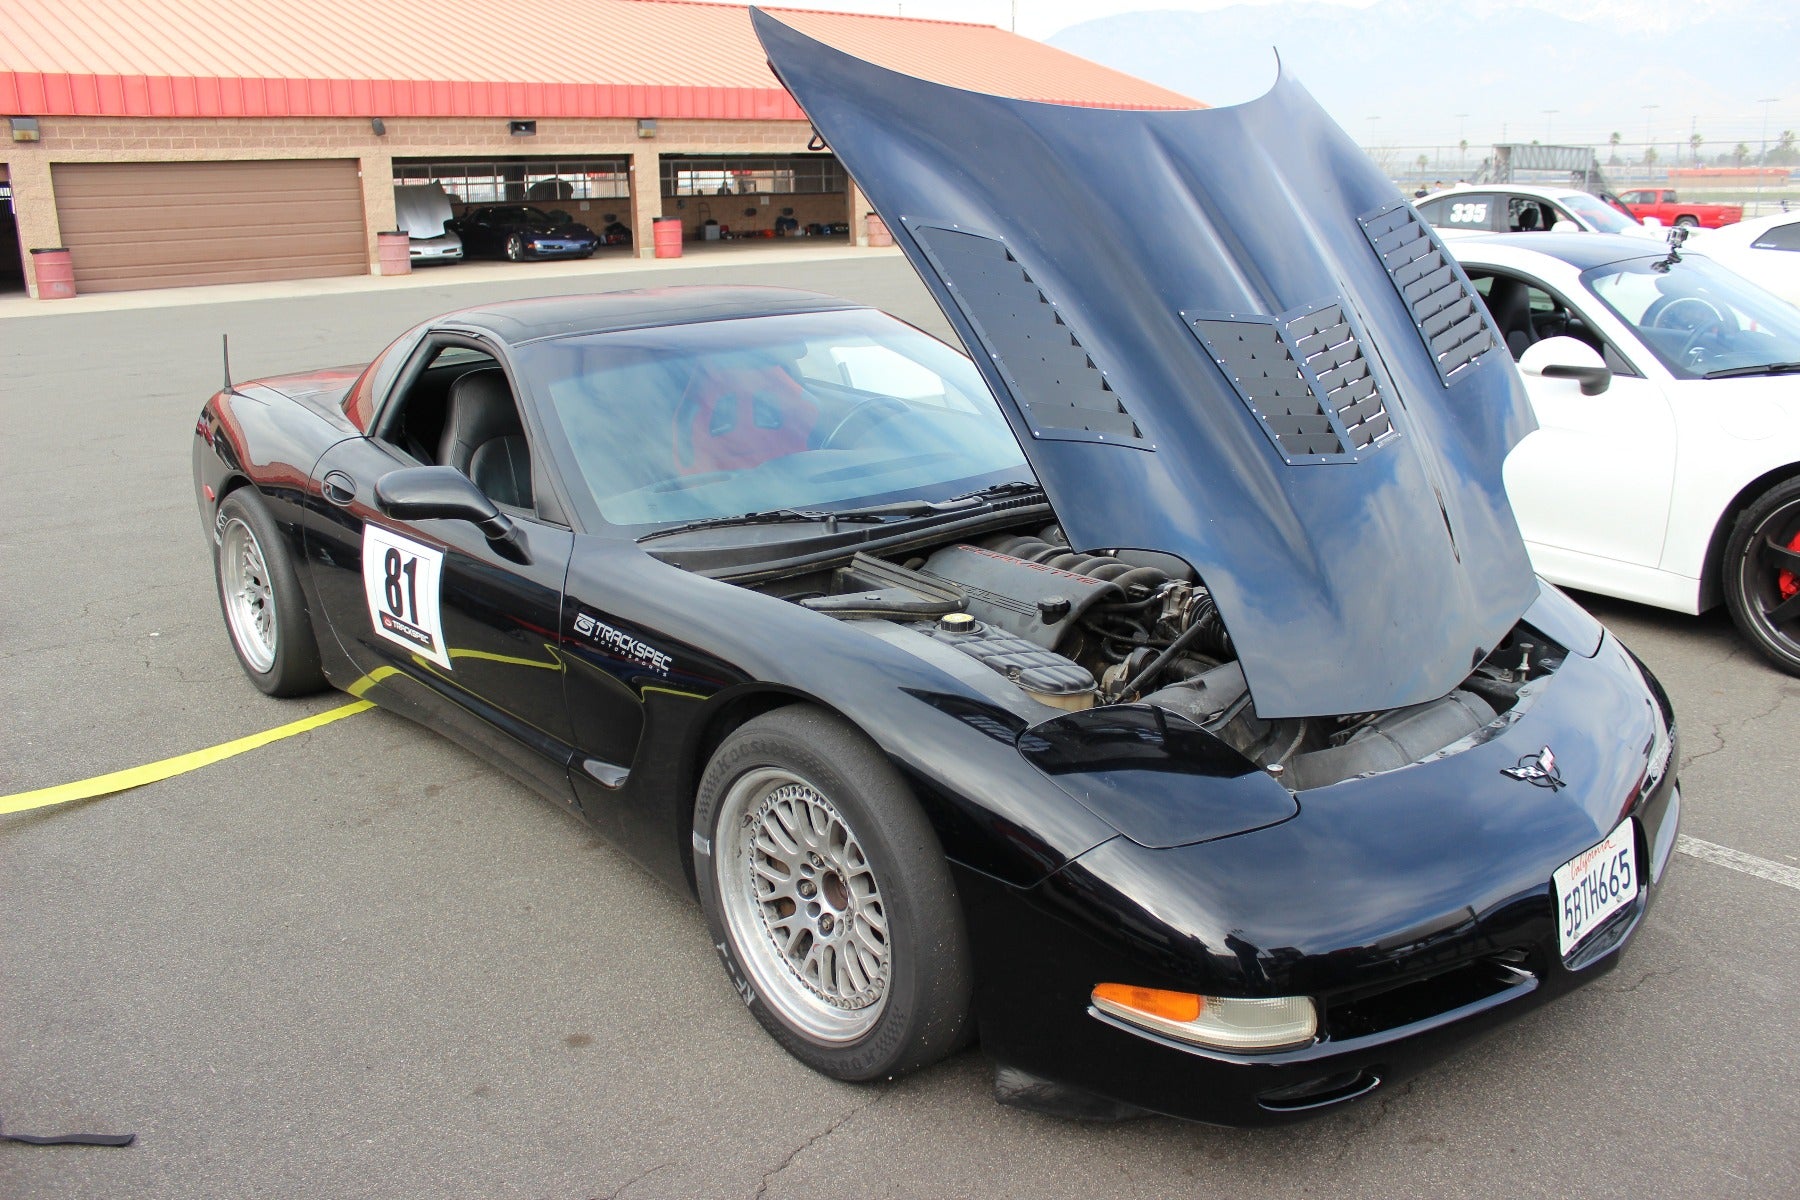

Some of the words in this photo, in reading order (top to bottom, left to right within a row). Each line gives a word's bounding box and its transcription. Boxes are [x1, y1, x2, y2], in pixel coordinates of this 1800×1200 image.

[1450, 203, 1488, 223] 335
[385, 547, 419, 626] 81
[595, 621, 673, 672] TRACKSPEC
[1569, 839, 1618, 881] California
[1563, 848, 1632, 938] 5BTH665
